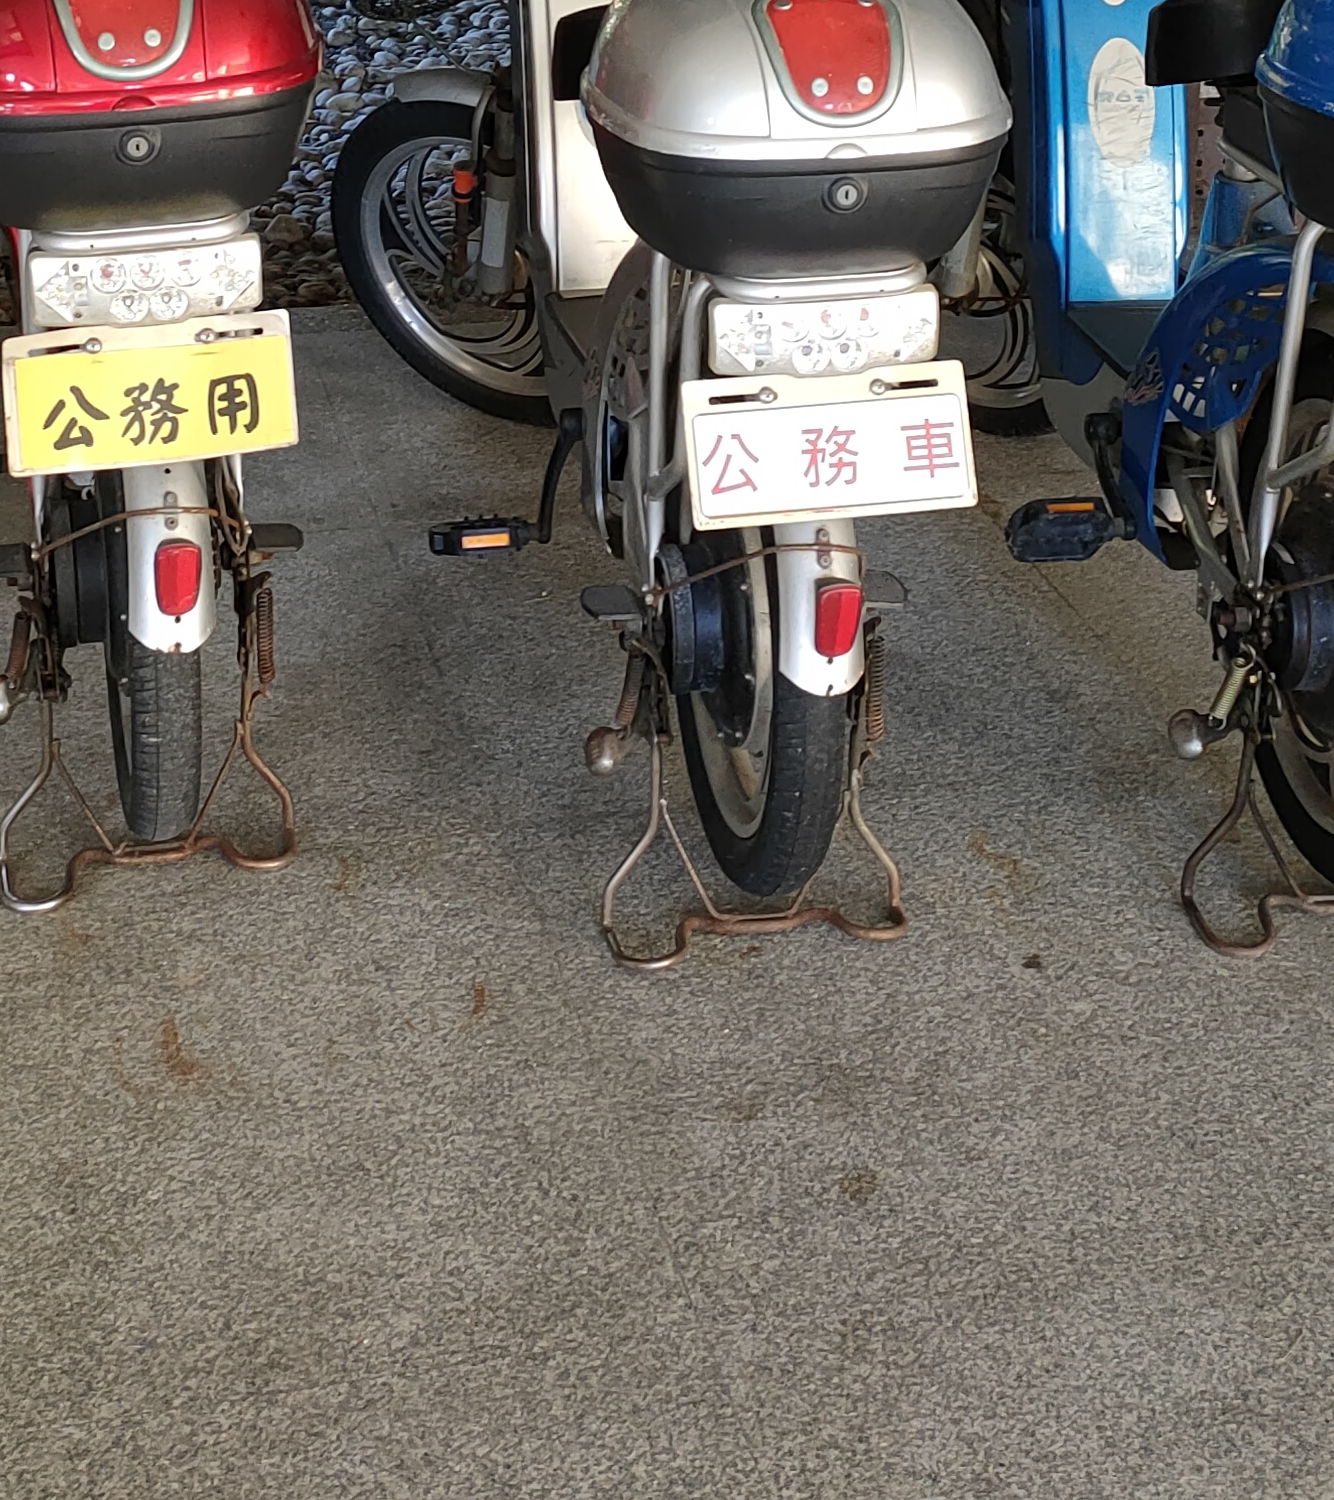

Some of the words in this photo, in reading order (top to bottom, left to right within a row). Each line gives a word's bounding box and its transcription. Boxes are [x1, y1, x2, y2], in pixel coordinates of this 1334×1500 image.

[43, 373, 260, 450] 公務用
[702, 419, 960, 495] 公務車
